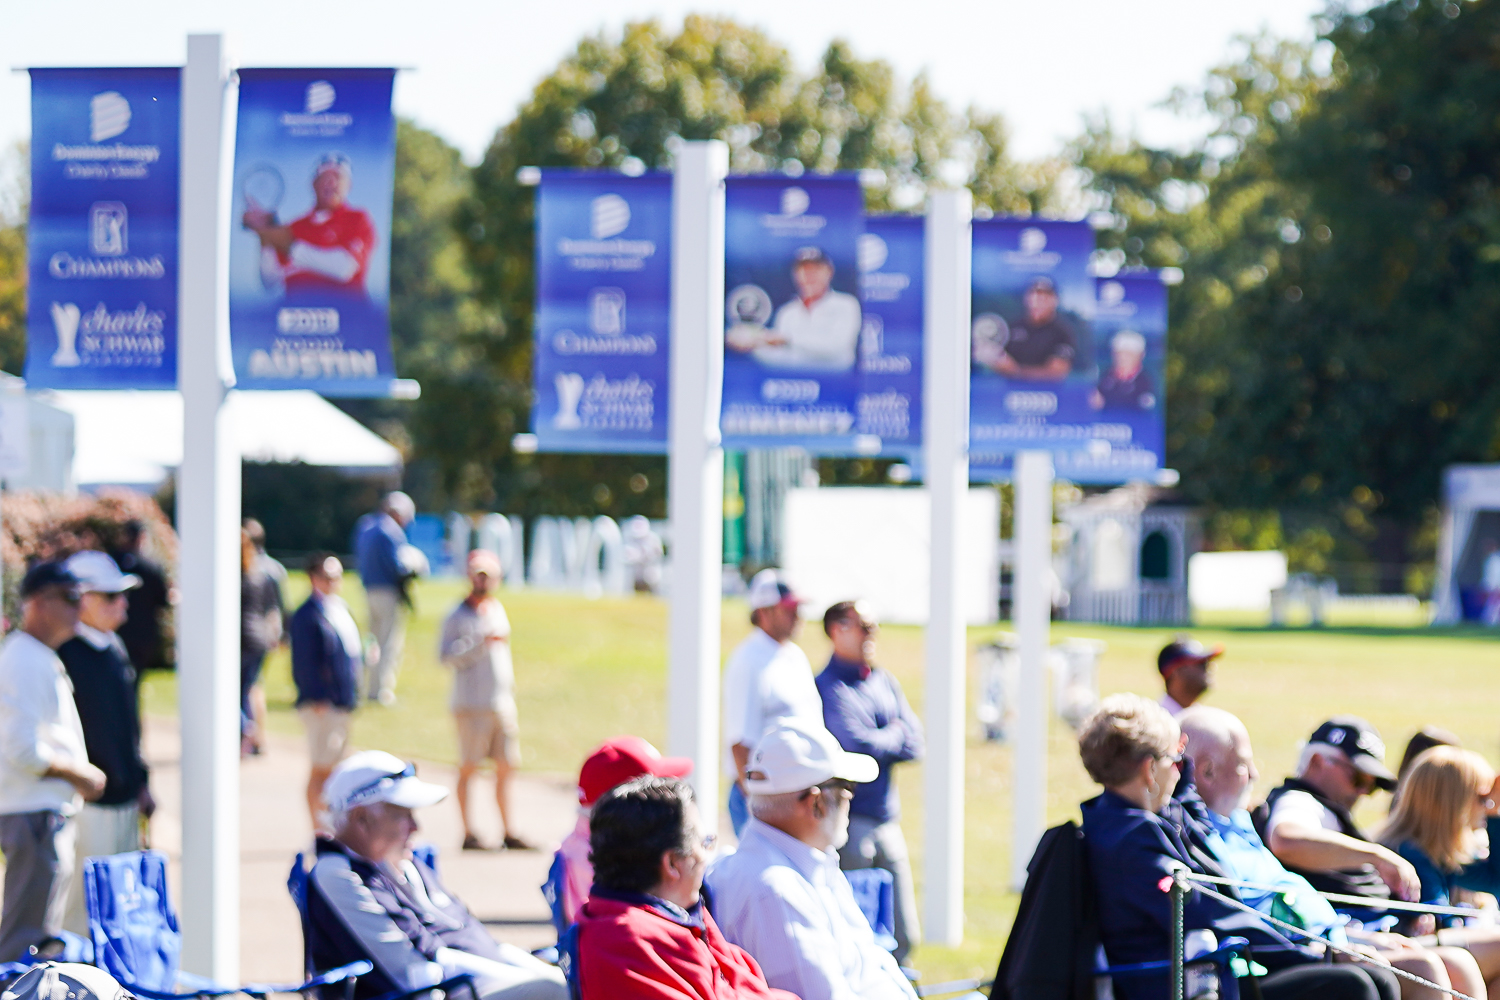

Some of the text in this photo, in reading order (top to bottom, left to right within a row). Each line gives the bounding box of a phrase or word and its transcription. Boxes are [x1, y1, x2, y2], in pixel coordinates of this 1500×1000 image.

[50, 252, 165, 278] CHAMPIONS
[81, 333, 165, 353] SCHWAB
[248, 349, 378, 378] AUSTIN
